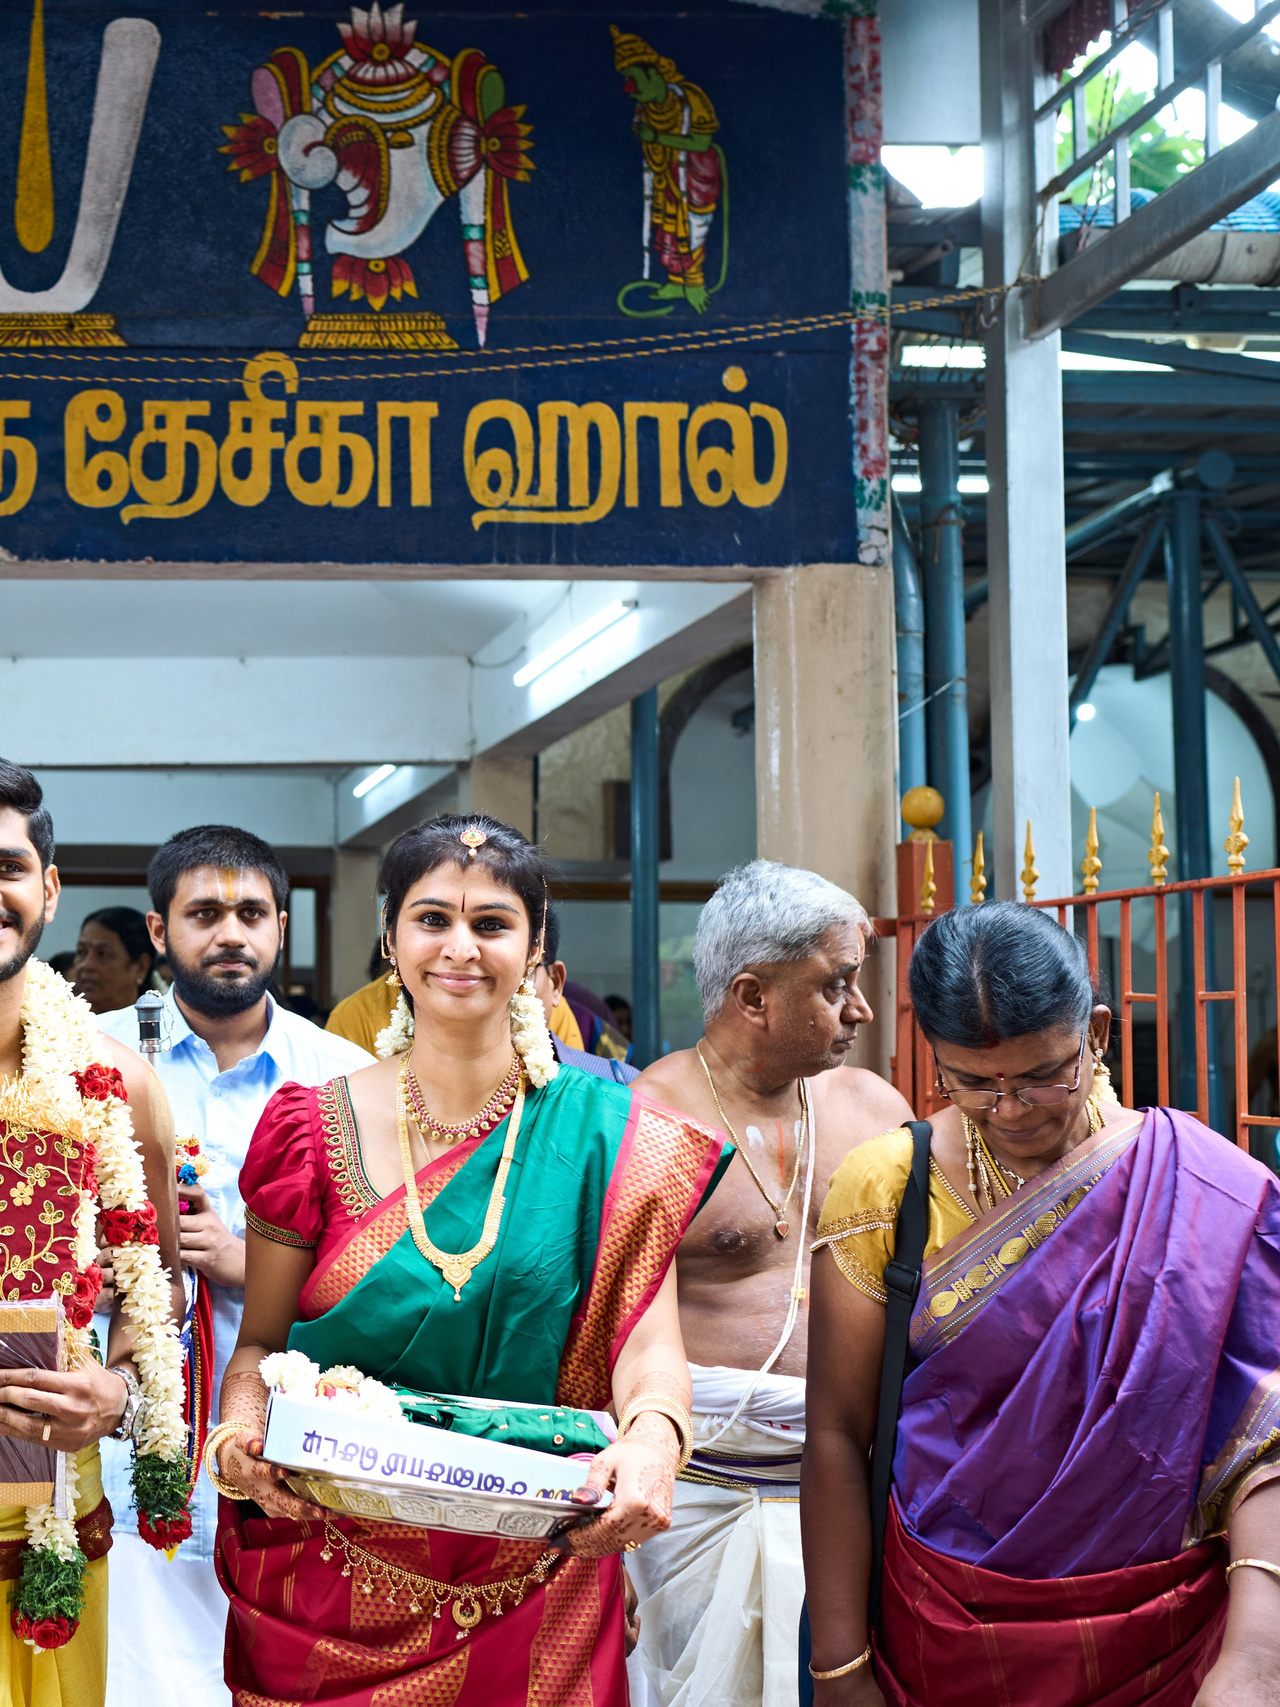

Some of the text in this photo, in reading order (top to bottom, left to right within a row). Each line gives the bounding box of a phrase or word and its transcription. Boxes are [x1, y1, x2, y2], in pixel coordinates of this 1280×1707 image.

[64, 351, 439, 526] தேசிகா
[463, 364, 789, 532] ஹால்
[302, 1430, 379, 1471] செட்டி
